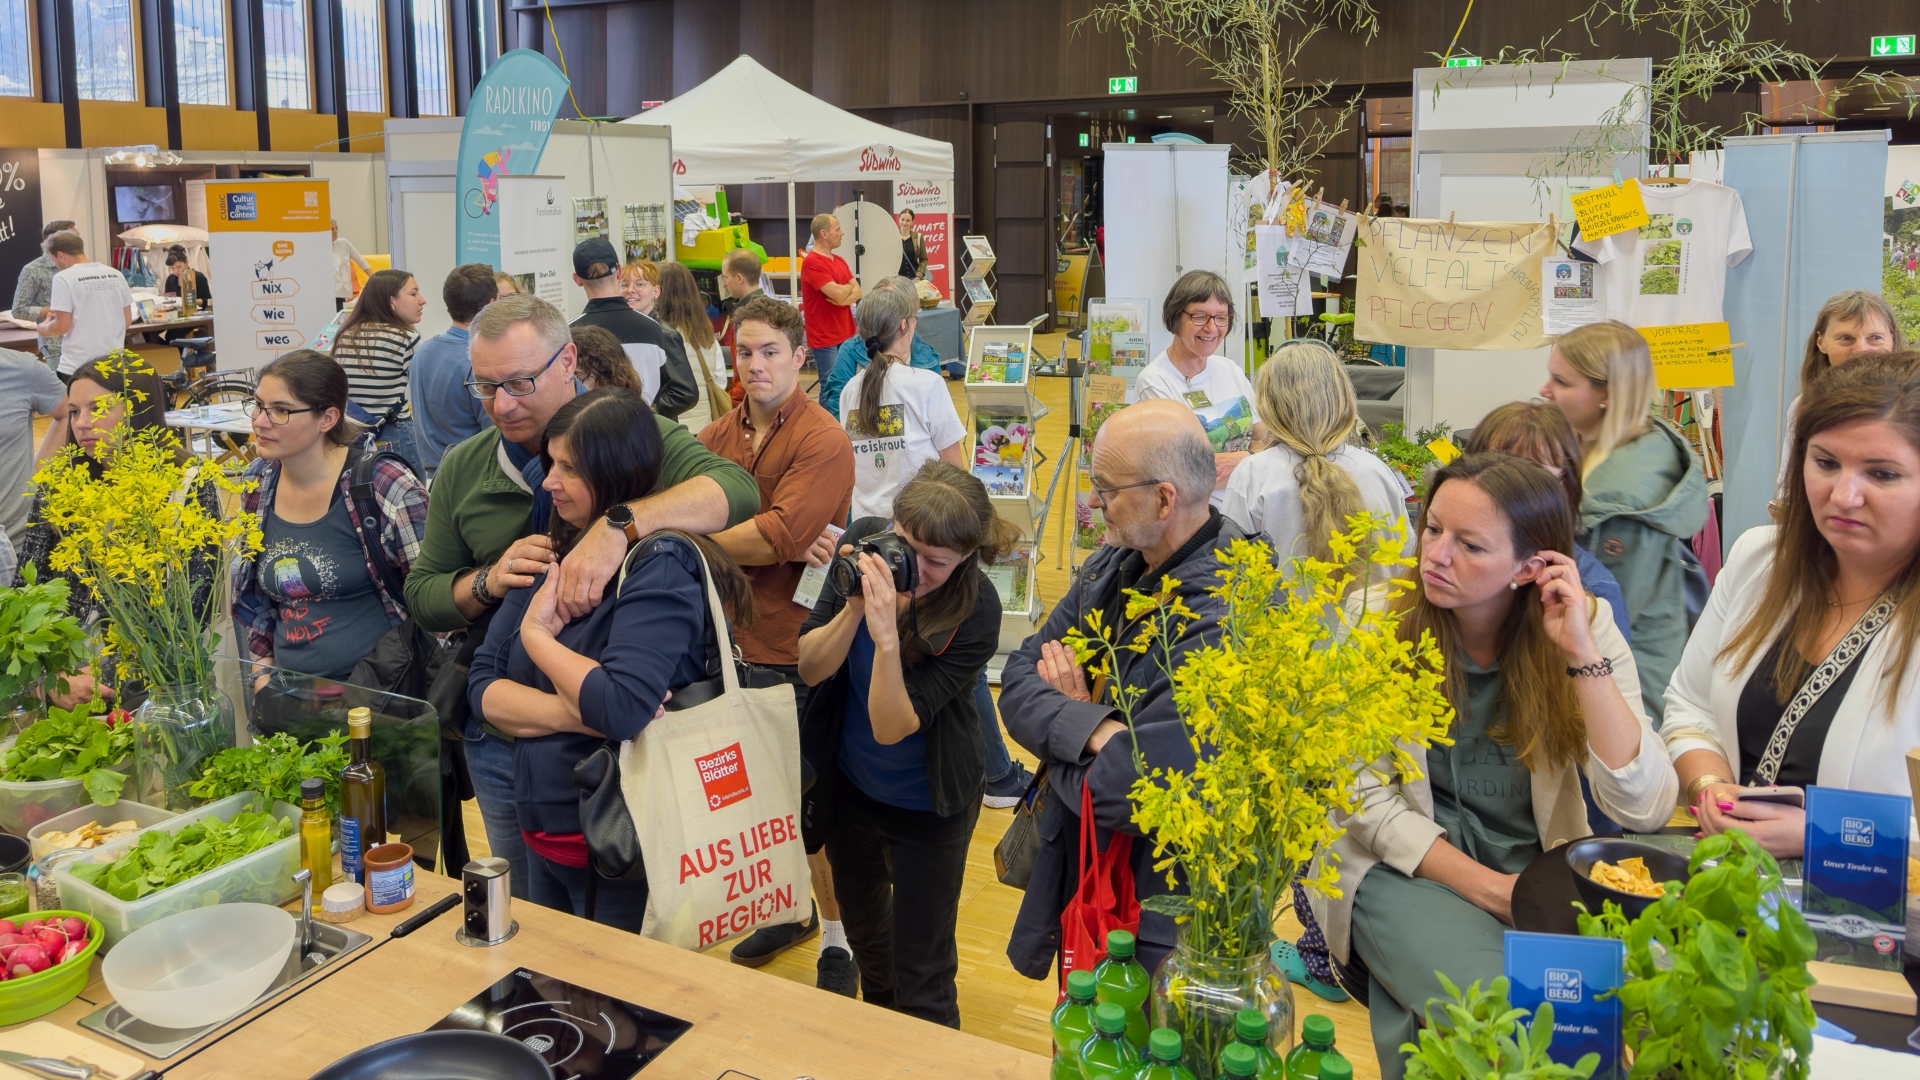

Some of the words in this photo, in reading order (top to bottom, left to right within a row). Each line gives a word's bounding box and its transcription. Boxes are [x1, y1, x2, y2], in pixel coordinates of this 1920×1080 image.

[486, 86, 553, 116] RADLKINO
[859, 146, 901, 172] SÜDWIND
[896, 182, 941, 196] SÜDWIND
[232, 194, 254, 203] Cultur
[219, 194, 227, 221] CUBIC
[229, 210, 256, 219] Context
[911, 221, 946, 233] IMATE
[1587, 222, 1627, 239] MATERIAL
[923, 233, 945, 243] TICE
[1367, 220, 1534, 255] PFLANZEN
[1503, 262, 1541, 342] EHRENAMTLICH
[1366, 295, 1494, 332] PFLEGEN
[1650, 325, 1701, 339] VORTRAG
[984, 355, 999, 363] Biber
[1009, 355, 1022, 363] Tirol
[854, 438, 906, 455] reiskraut
[285, 616, 333, 645] WOLF
[698, 750, 737, 772] Bezirks
[702, 762, 738, 783] Blätter
[1845, 819, 1863, 830] BIO
[1844, 833, 1871, 845] BERG
[680, 838, 734, 885] AUS
[739, 814, 798, 859] LIEBE
[1823, 859, 1846, 869] Unser
[1847, 862, 1872, 873] Tiroler
[1873, 866, 1889, 875] Bio.
[723, 858, 773, 903] ZUR
[698, 883, 798, 949] REGION.
[1549, 971, 1569, 982] BIO
[1548, 988, 1578, 1000] BERG
[1553, 1022, 1581, 1034] Tiroler
[1582, 1025, 1600, 1035] Bio.
